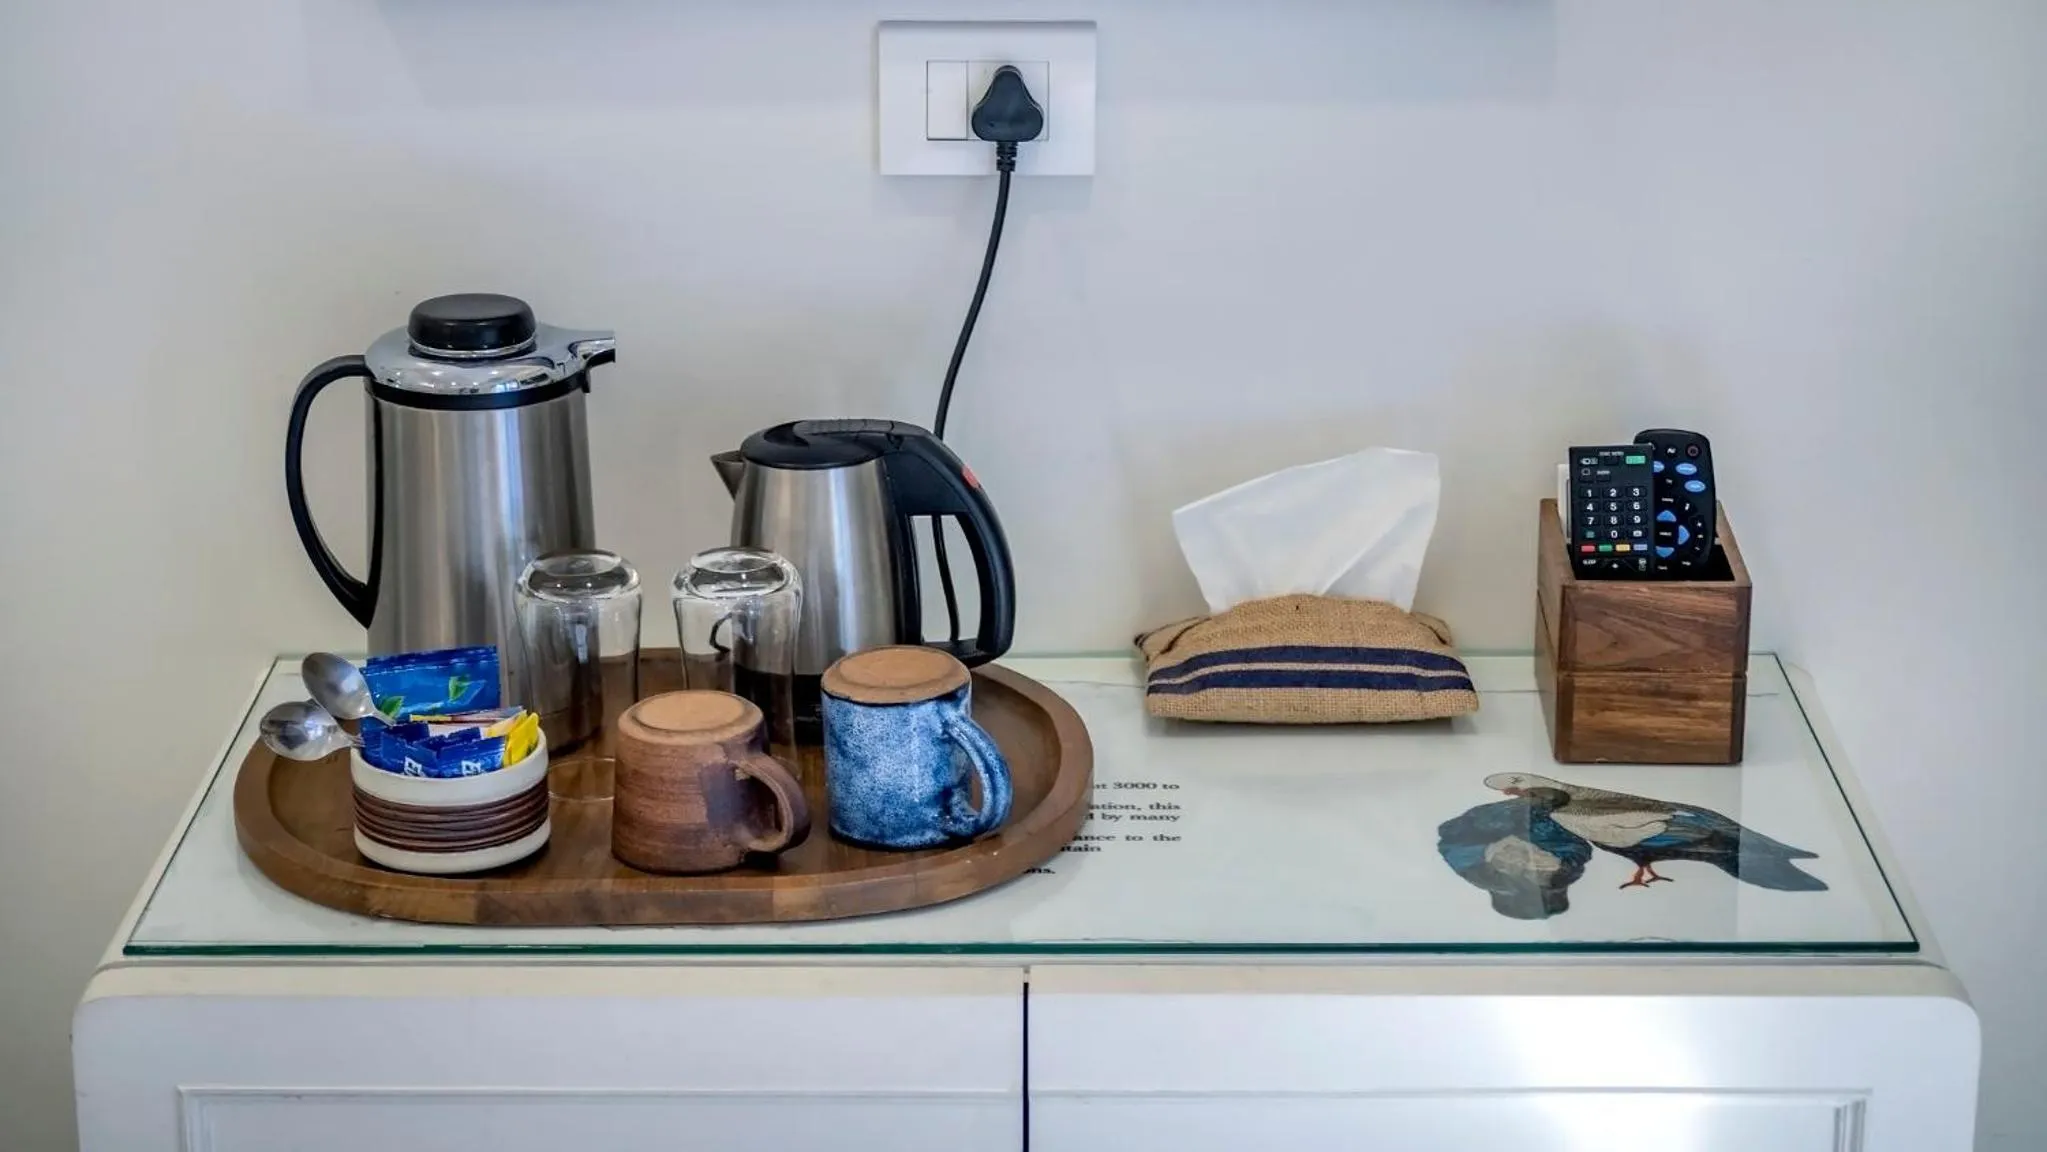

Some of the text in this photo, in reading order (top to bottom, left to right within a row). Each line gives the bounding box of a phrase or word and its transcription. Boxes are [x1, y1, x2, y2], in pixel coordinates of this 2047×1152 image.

[1587, 488, 1640, 497] 1 2 3
[1586, 501, 1640, 511] 4 5 6
[1587, 515, 1641, 525] 7 8 9
[1610, 530, 1618, 539] 0
[1113, 782, 1158, 790] 3000
[1149, 802, 1181, 810] this
[1101, 813, 1123, 822] by
[1130, 814, 1180, 822] many
[1125, 833, 1144, 842] to
[1153, 833, 1182, 842] the
